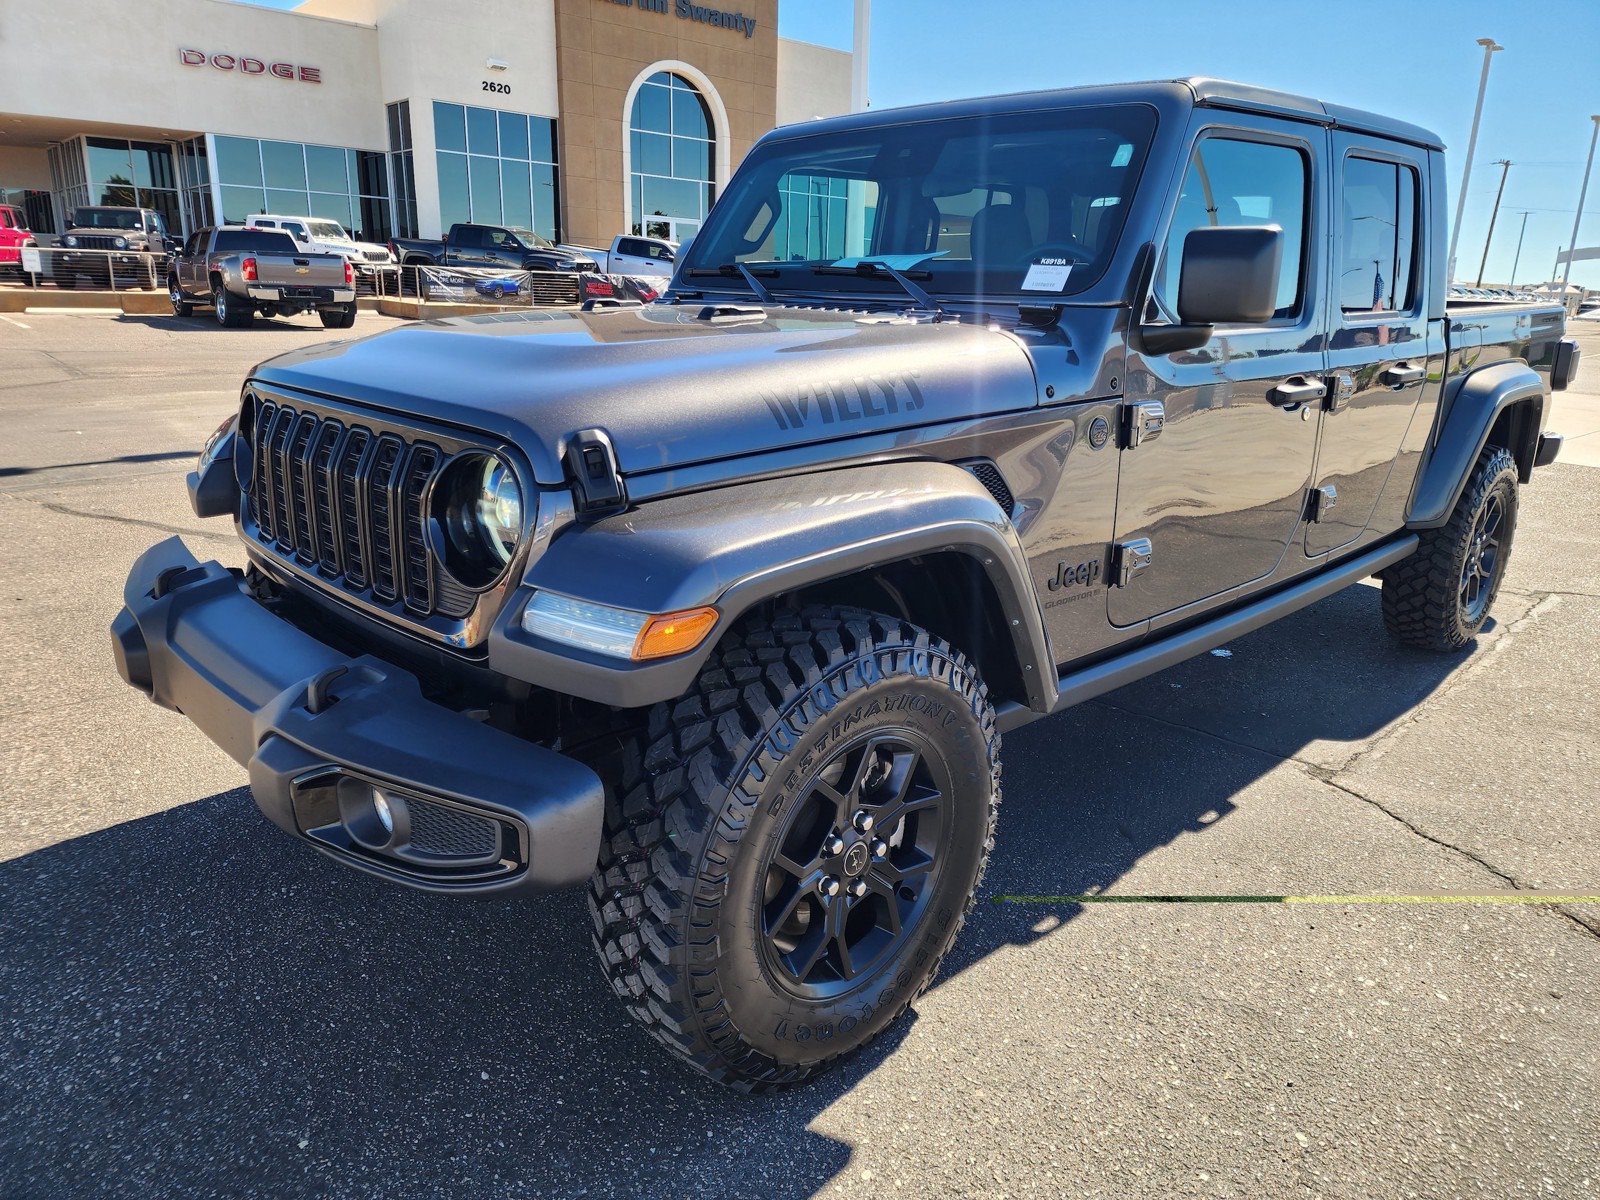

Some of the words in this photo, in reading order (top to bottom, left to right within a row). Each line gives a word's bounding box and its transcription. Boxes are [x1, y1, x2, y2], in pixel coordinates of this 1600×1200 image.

[675, 0, 757, 39] Swanty
[179, 48, 322, 84] DODGE
[481, 80, 512, 95] 2620
[758, 370, 925, 431] WILLYS
[1047, 559, 1100, 592] Jeep
[1044, 590, 1093, 610] GLADIATOR
[766, 692, 948, 819] DESTINATION
